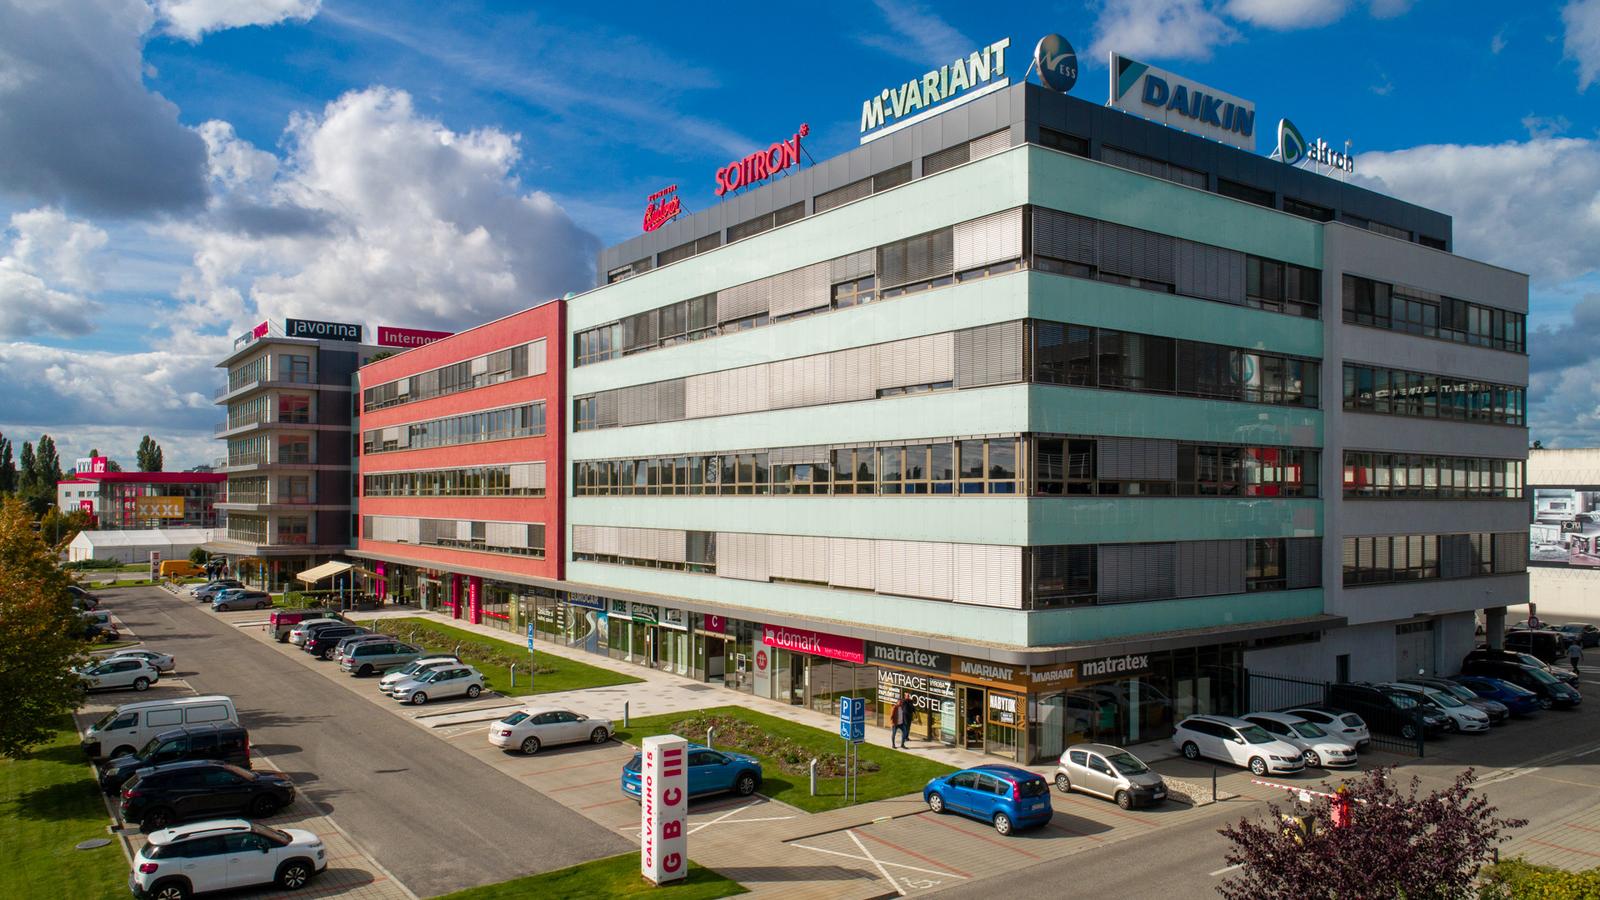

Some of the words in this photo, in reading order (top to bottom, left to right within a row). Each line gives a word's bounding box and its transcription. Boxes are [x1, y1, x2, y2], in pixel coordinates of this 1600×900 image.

[1141, 74, 1255, 137] DAIKIN
[715, 133, 800, 196] SOITRON
[292, 320, 357, 337] javorina
[139, 504, 182, 517] XXXL
[712, 615, 718, 627] C
[776, 628, 821, 652] domark
[874, 645, 937, 668] matratex
[1082, 654, 1149, 677] matratex
[960, 661, 1014, 681] MVARIANT
[1031, 668, 1074, 683] MVARIANT
[878, 670, 927, 691] MATRACE
[842, 700, 849, 714] P
[855, 701, 862, 715] P
[646, 752, 653, 769] 15
